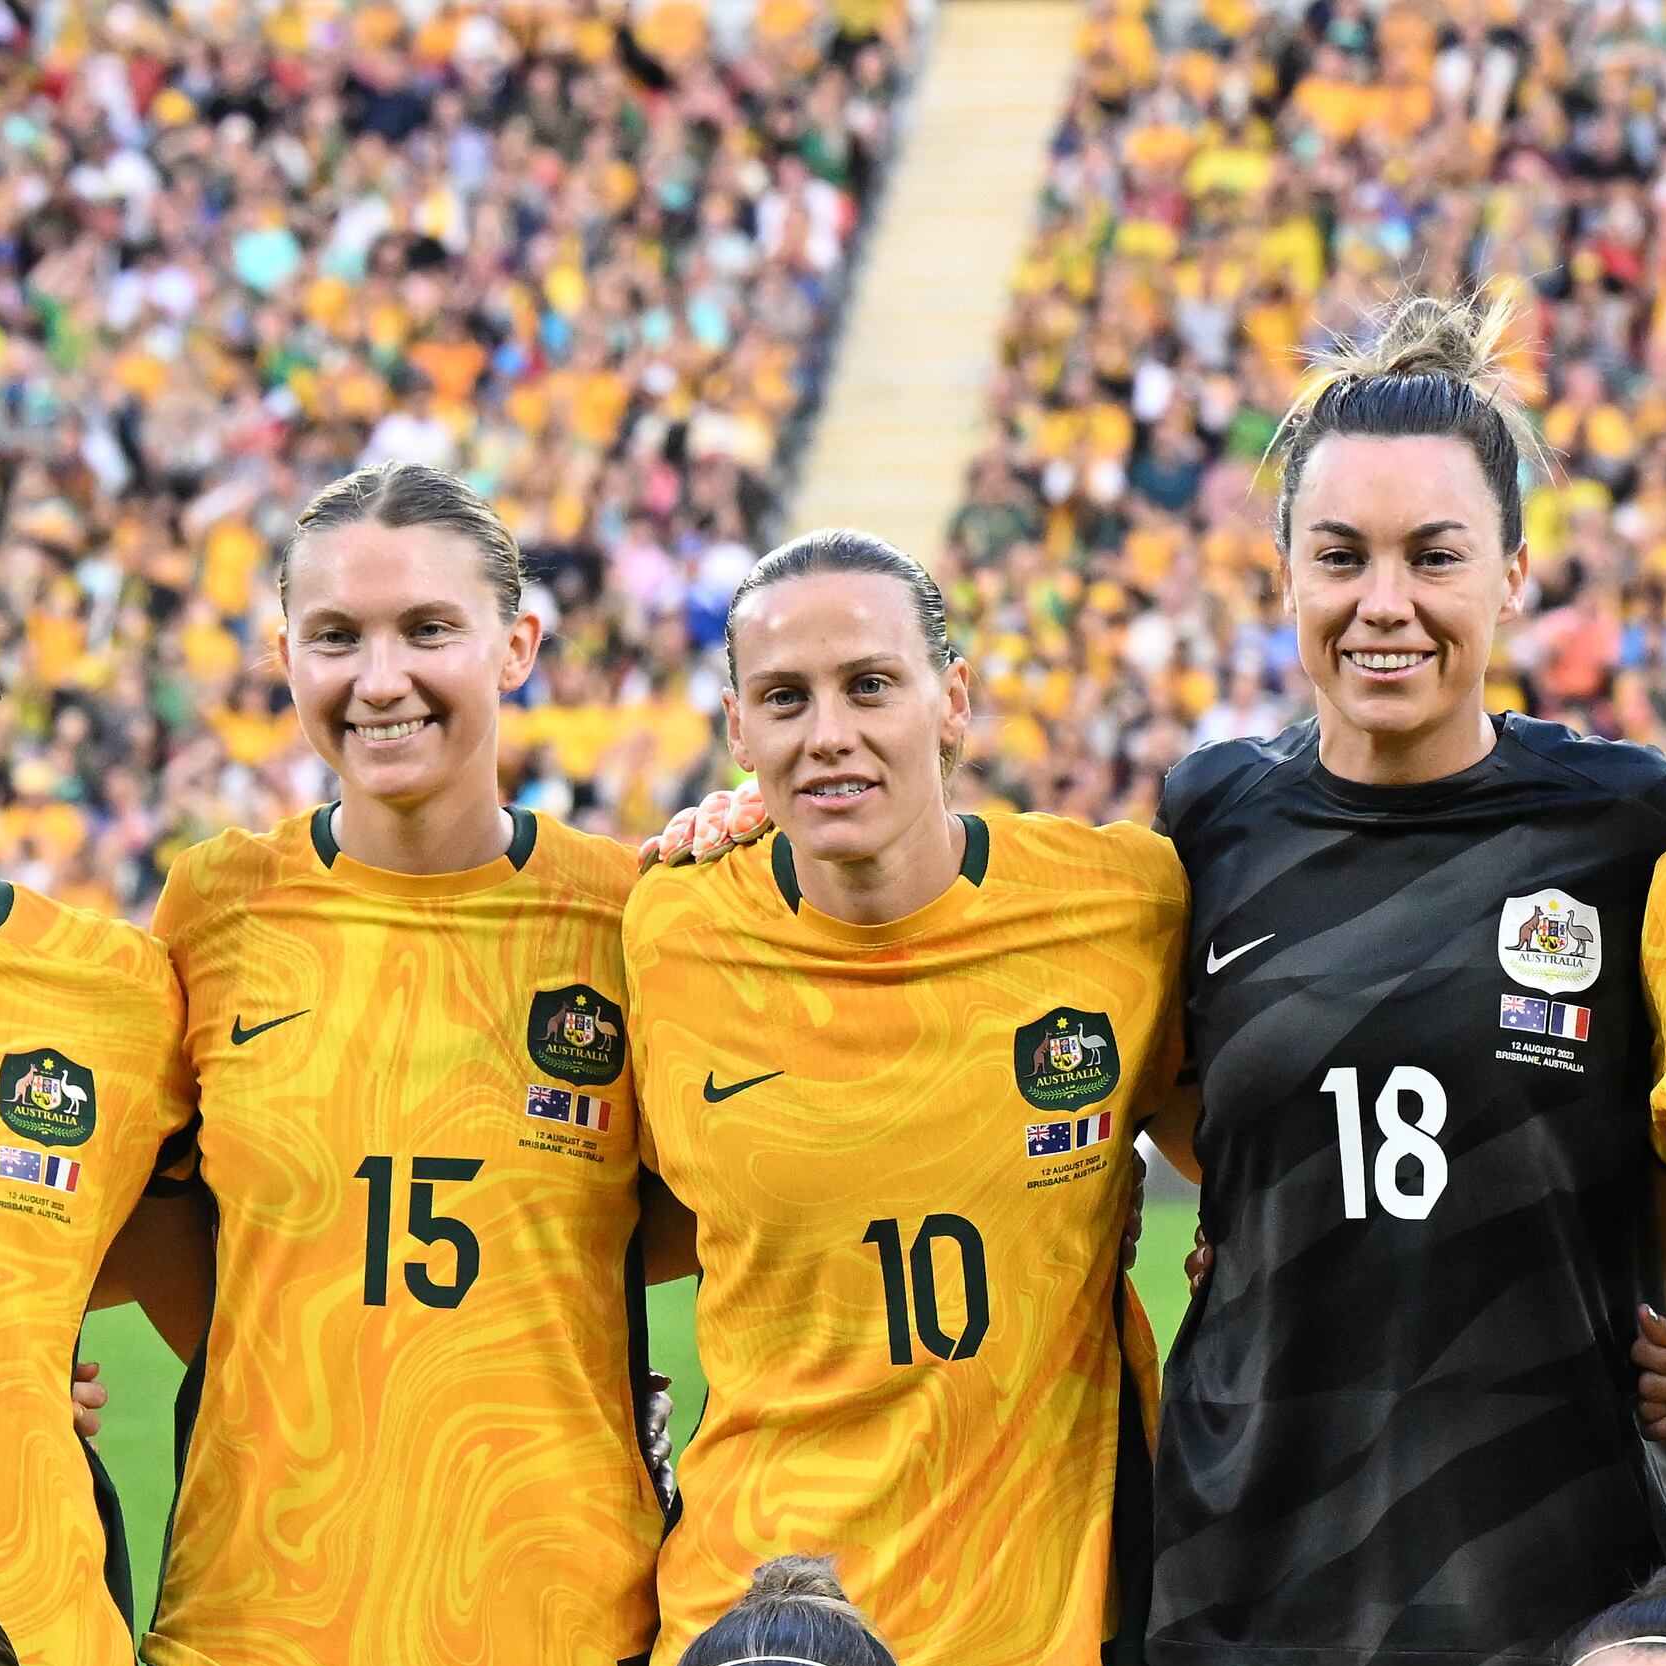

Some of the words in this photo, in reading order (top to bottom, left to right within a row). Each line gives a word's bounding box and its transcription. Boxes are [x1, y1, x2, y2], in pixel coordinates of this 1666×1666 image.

[1519, 953, 1583, 968] AUSTRALIA
[546, 1044, 609, 1063] AUSTRALIA
[1511, 1041, 1521, 1051] 12
[1523, 1042, 1557, 1056] AUGUST
[1557, 1049, 1575, 1060] 2023
[1495, 1050, 1542, 1066] BRISBANE,
[1543, 1057, 1585, 1074] AUSTRALIA
[1036, 1067, 1102, 1087] AUSTRALIA
[14, 1105, 77, 1126] AUSTRALIA
[519, 1139, 565, 1155] BRISBANE,
[535, 1131, 545, 1140] 12
[546, 1133, 581, 1146] AUGUST
[1318, 1065, 1449, 1220] 18
[1041, 1168, 1052, 1176] 12
[1052, 1161, 1084, 1174] AUGUST
[1073, 1160, 1108, 1180] AUSTRALIA
[8, 1191, 17, 1200] 12
[18, 1193, 49, 1206] AUGUST
[37, 1208, 71, 1224] AUSTRALIA
[353, 1155, 486, 1310] 15
[861, 1213, 990, 1365] 10
